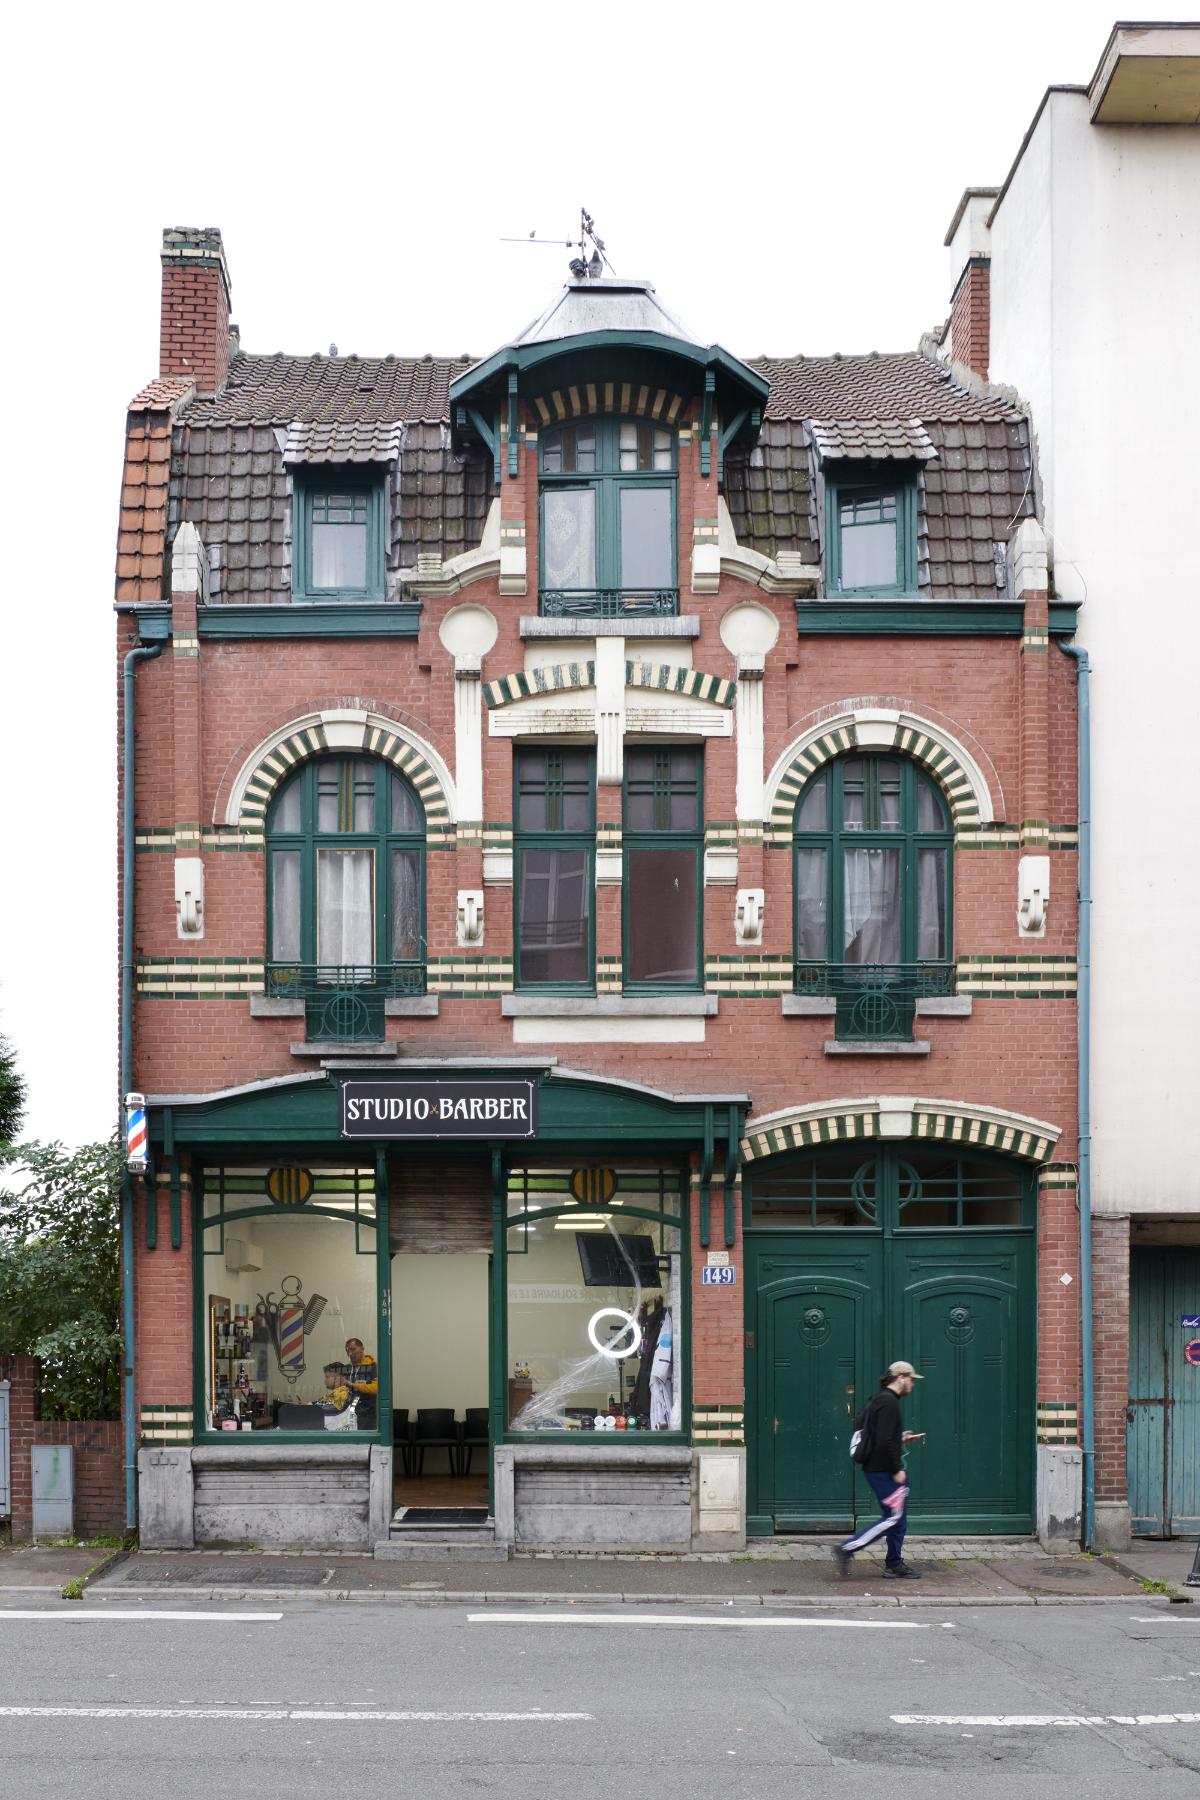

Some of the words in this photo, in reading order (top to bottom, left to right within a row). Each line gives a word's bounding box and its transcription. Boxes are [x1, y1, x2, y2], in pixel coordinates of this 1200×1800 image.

[347, 1098, 429, 1120] STUDIO
[439, 1098, 528, 1120] BARBER
[705, 1268, 732, 1284] 149
